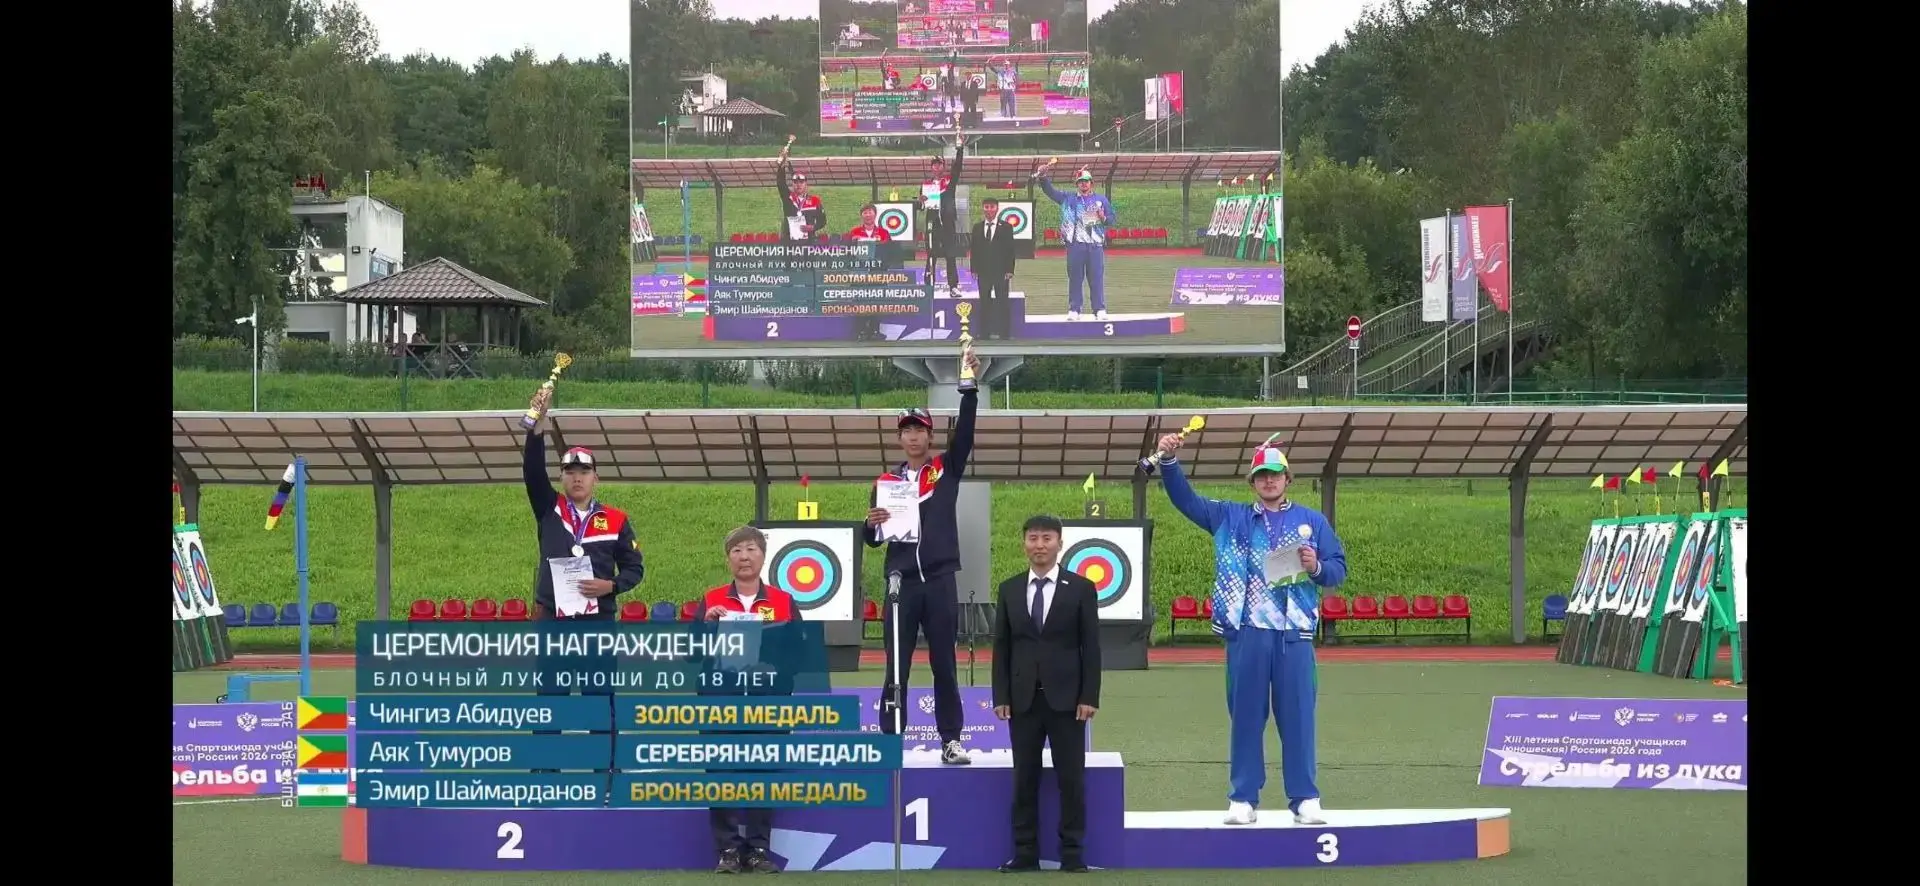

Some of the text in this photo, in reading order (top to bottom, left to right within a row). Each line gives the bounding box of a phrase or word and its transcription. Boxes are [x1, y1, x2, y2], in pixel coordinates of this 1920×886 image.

[715, 245, 869, 258] ЦЕРЕМОНИЯ НАГРАЖДЕНИЯ
[715, 260, 763, 269] БЛОЧНЫЙ
[832, 261, 845, 269] ДО
[864, 260, 882, 268] ЛЕТ
[714, 274, 790, 285] Чингиз Абидуев
[823, 273, 909, 284] ЗОЛОТАЯ МЕДАЛЬ
[714, 289, 773, 301] Аяк Тумуров
[823, 288, 926, 299] СЕРЕБРЯНАЯ МЕДАЛЬ
[714, 304, 808, 316] Эмир Шаймарданов
[821, 304, 920, 315] БРОНЗОВАЯ МЕДАЛЬ
[934, 310, 946, 329] 1
[766, 322, 779, 338] 2
[1104, 323, 1114, 336] 3
[806, 505, 811, 518] 1
[1091, 503, 1100, 516] 2
[185, 743, 261, 753] Спартакиада
[1562, 736, 1632, 747] Спартакиада
[1634, 738, 1687, 748] учащихся
[197, 753, 239, 761] России
[240, 752, 268, 761] 2026
[1570, 745, 1608, 755] России
[1610, 746, 1636, 755] 2026
[1638, 748, 1662, 757] года
[1636, 763, 1671, 779] из
[1677, 763, 1742, 785] лука
[905, 798, 929, 841] 1
[497, 821, 525, 859] 2
[1316, 832, 1339, 863] 3
